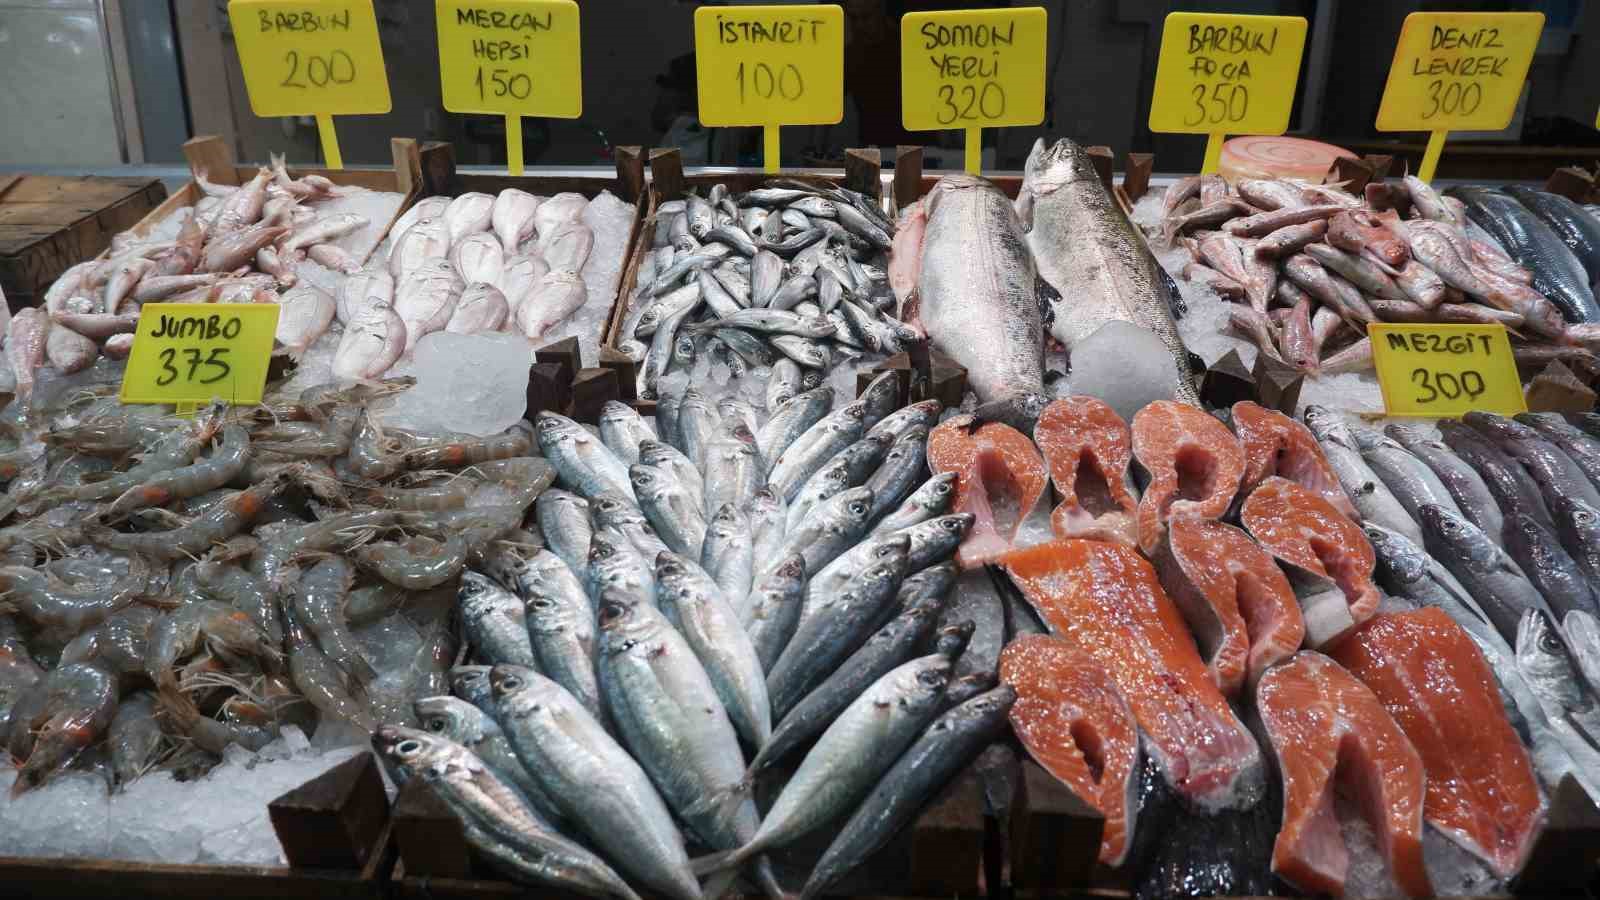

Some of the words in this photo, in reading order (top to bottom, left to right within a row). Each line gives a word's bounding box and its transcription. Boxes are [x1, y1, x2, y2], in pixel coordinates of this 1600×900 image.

[257, 9, 350, 33] BARBUN
[456, 8, 553, 32] MERCAN
[920, 20, 1015, 51] SOMON
[1187, 24, 1279, 55] BARBUN
[281, 50, 356, 89] 200
[474, 66, 532, 102] 150
[736, 61, 805, 104] 100
[1412, 56, 1510, 78] LEVREK
[937, 81, 1006, 124] 320
[1184, 82, 1249, 127] 350
[1421, 79, 1482, 120] 300
[150, 314, 242, 340] JUMBO
[156, 347, 231, 387] 375
[1411, 368, 1486, 404] 300
